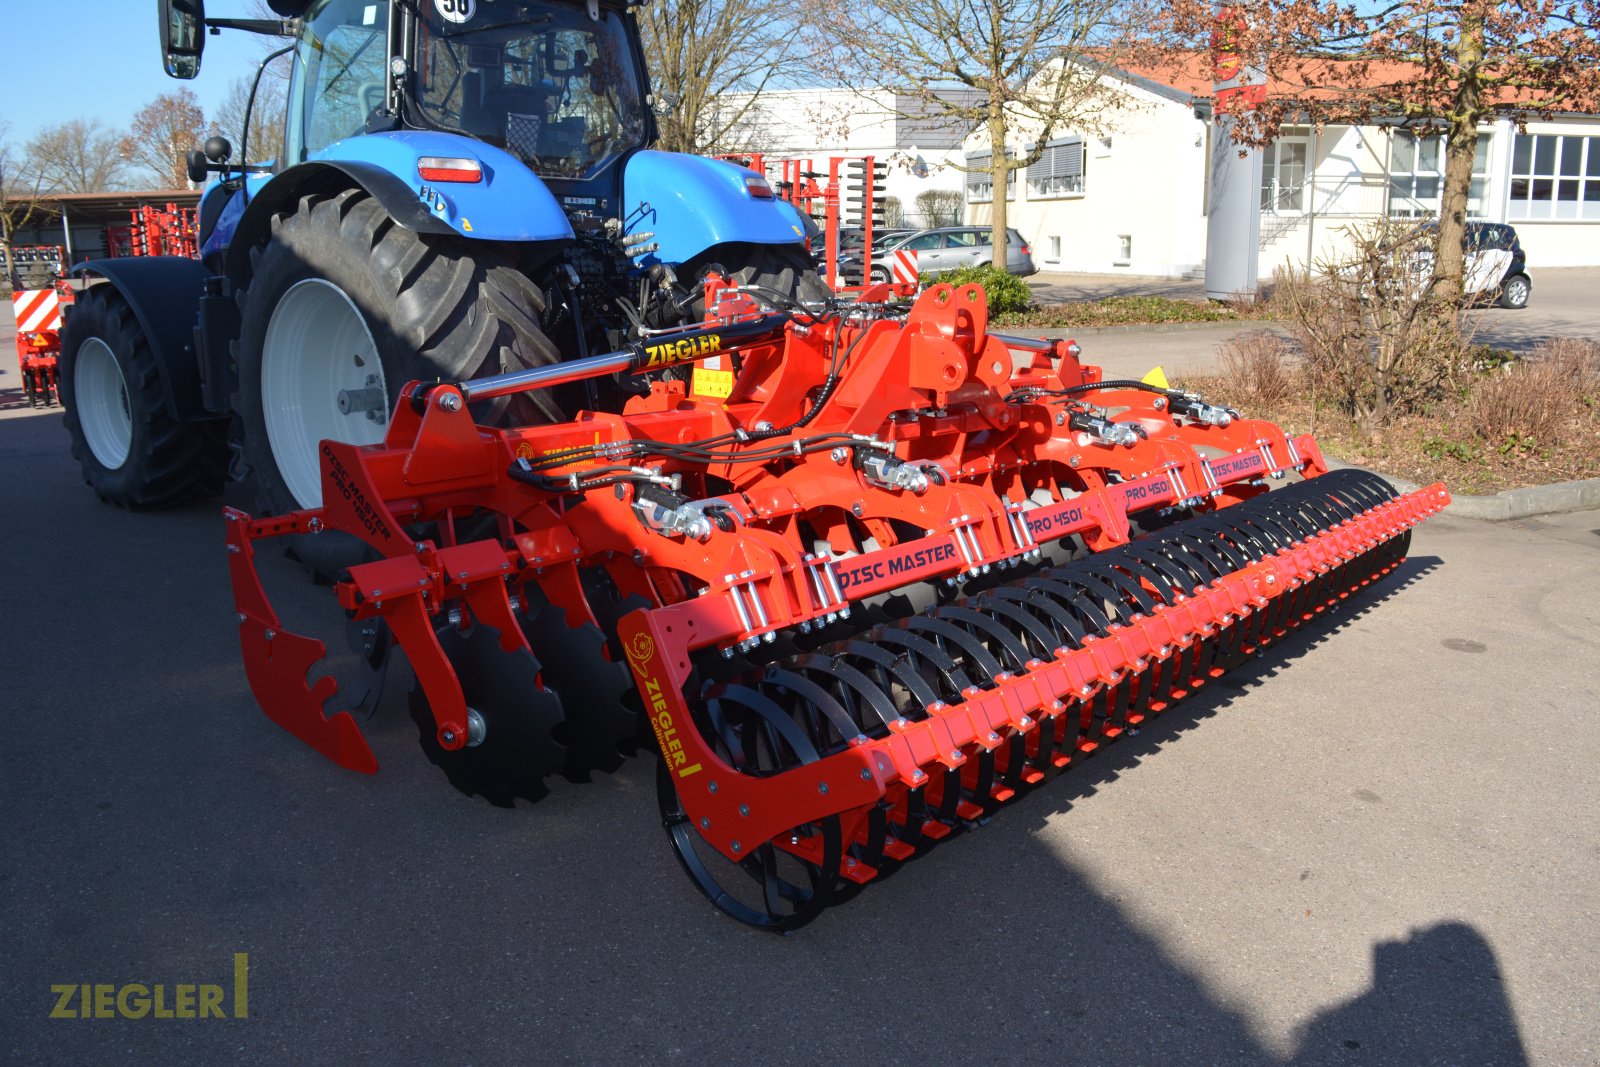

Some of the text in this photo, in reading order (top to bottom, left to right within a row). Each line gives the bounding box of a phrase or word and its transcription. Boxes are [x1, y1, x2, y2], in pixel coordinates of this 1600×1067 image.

[645, 334, 721, 367] ZIEGLER
[1210, 455, 1262, 477] DISC MASTER
[323, 446, 391, 540] DISC MASTER
[330, 470, 376, 535] PRO 4501
[1125, 486, 1147, 500] PRO
[1027, 508, 1083, 534] PRO 4501
[838, 543, 956, 590] DISC MASTER
[644, 677, 687, 767] ZIEGLER
[651, 717, 674, 771] Cultivation
